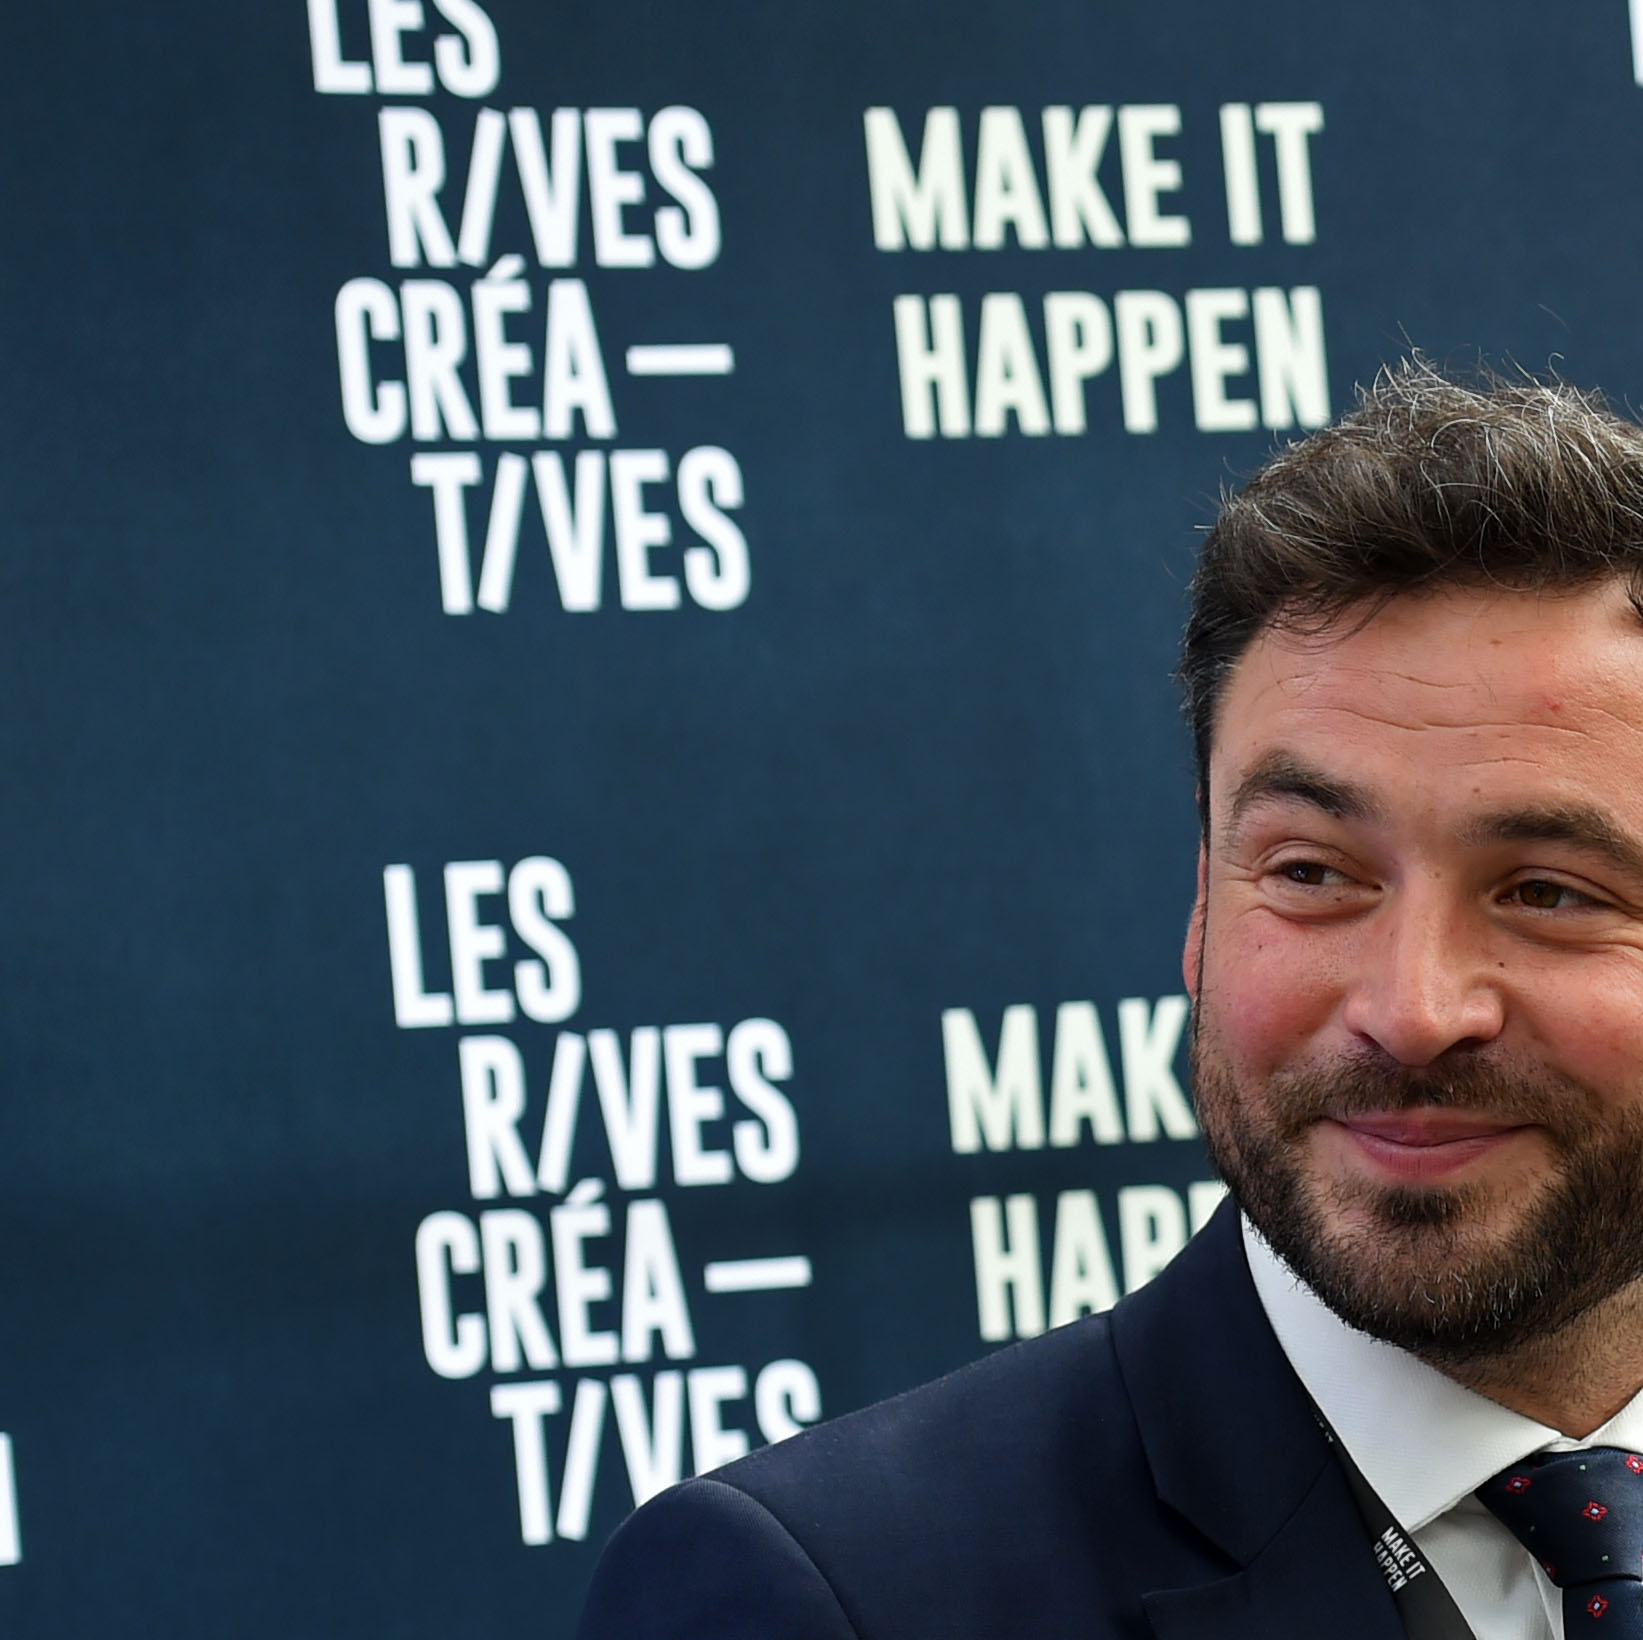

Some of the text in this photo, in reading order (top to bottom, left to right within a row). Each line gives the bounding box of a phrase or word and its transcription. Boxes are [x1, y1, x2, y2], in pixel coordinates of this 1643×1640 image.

[306, 0, 500, 98] LES
[863, 102, 1324, 251] MAKE IT
[893, 285, 1331, 439] HAPPEN
[382, 855, 582, 1029] LES
[941, 995, 1199, 1155] MAK
[970, 1181, 1231, 1341] HAP
[1381, 1526, 1426, 1580] MAKE IT
